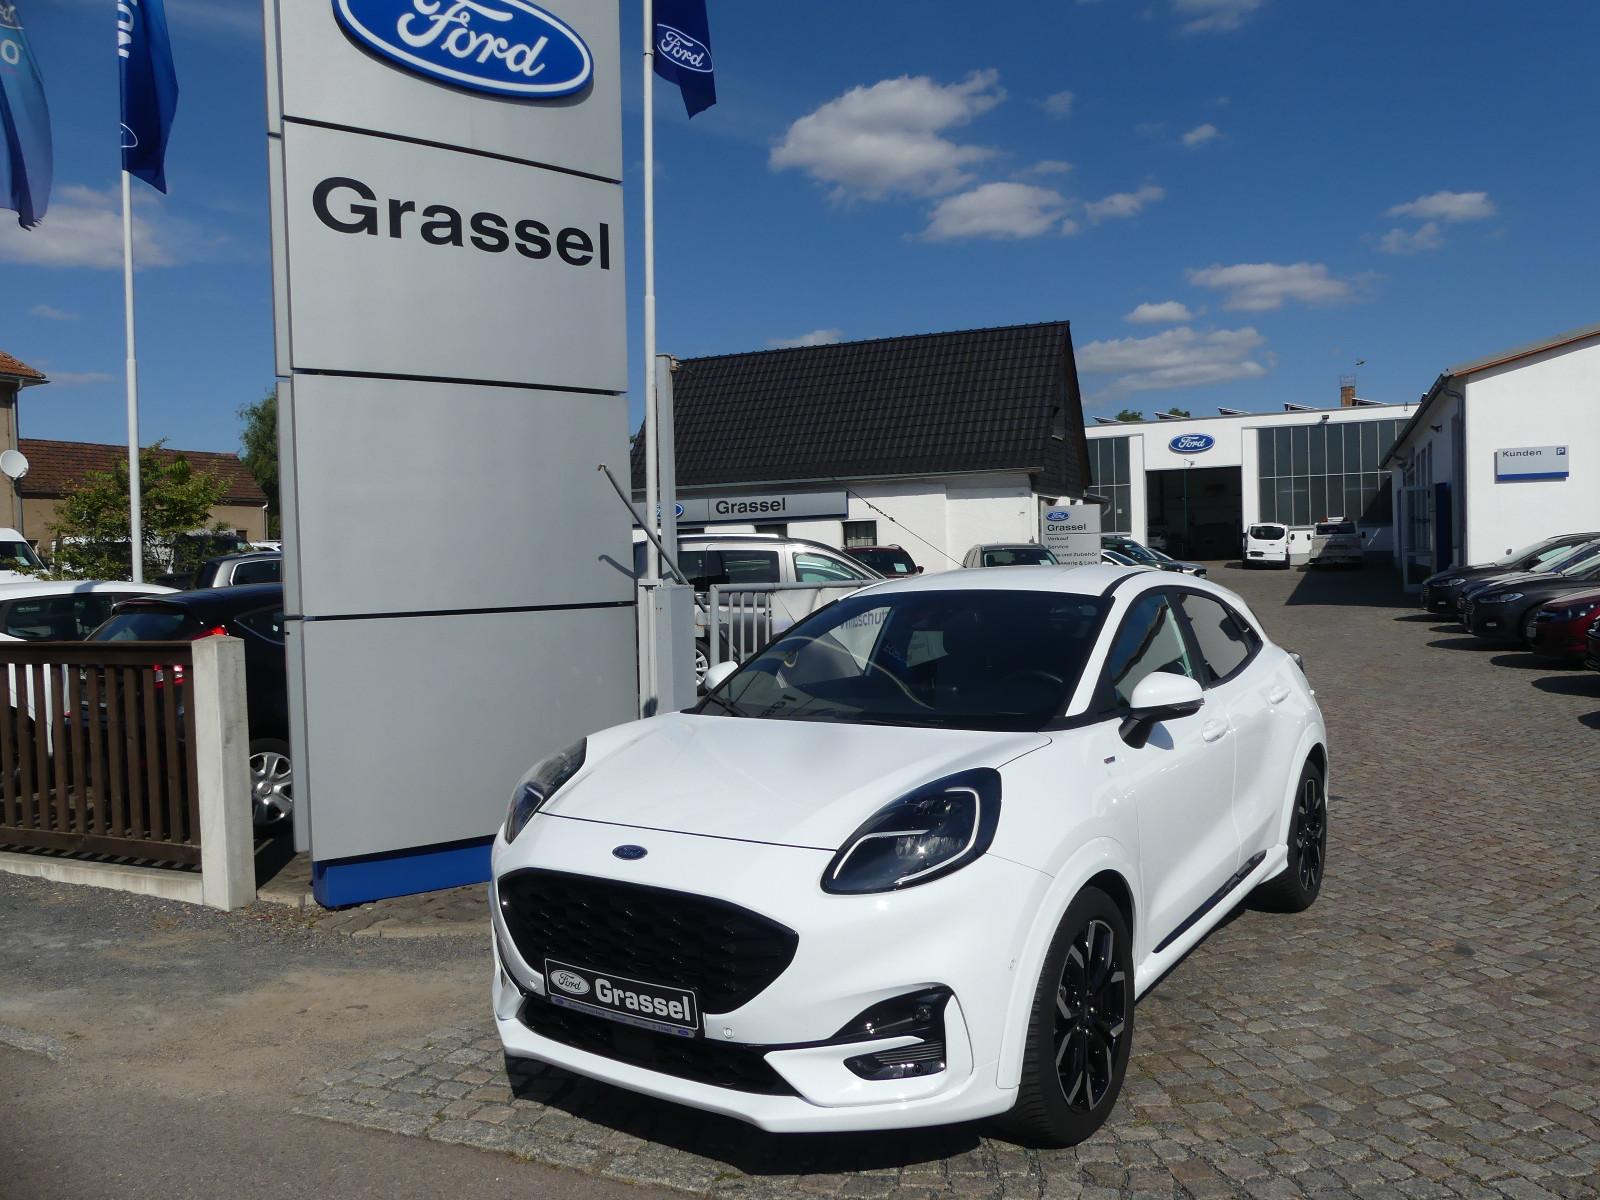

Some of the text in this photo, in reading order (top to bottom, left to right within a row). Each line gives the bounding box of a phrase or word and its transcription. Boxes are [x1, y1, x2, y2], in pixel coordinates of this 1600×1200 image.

[397, 0, 549, 77] Ford
[661, 31, 705, 67] Ford
[312, 176, 611, 270] Grassel
[1178, 436, 1206, 448] Ford
[1502, 449, 1542, 457] Kunden
[715, 497, 786, 514] Grassel
[1047, 523, 1086, 531] Grassel
[558, 972, 581, 991] Ford
[594, 978, 692, 1022] Grassel
